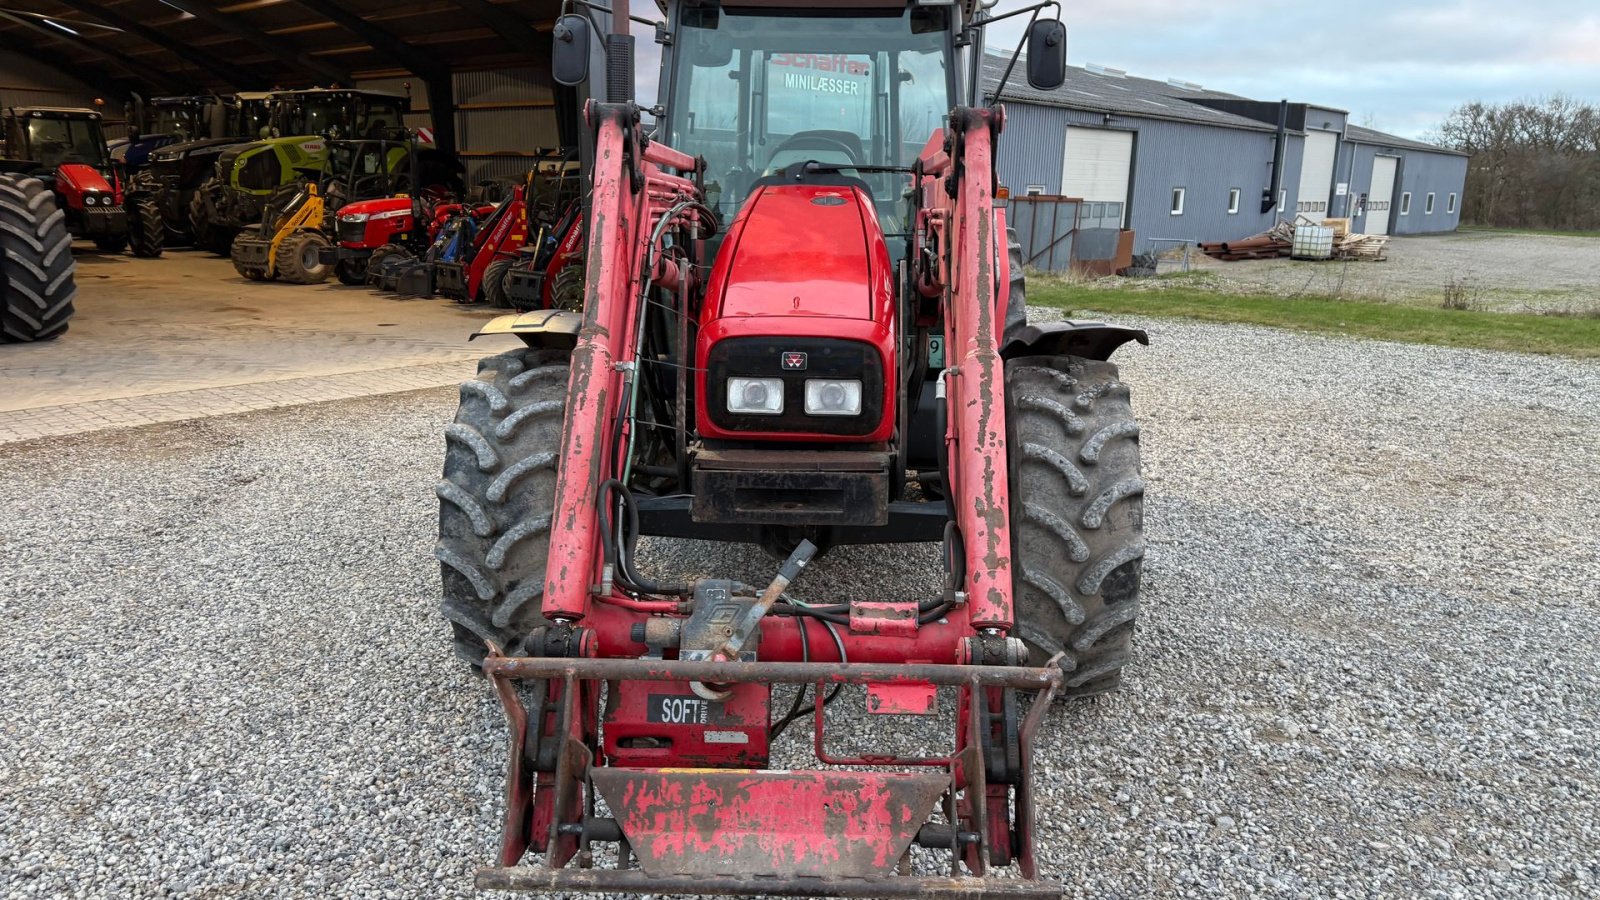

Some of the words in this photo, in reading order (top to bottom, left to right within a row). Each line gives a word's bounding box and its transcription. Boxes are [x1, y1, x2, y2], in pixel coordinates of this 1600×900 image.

[785, 73, 858, 95] MINILÆSSER
[661, 698, 700, 723] SOFT
[700, 700, 709, 724] DRIVE
